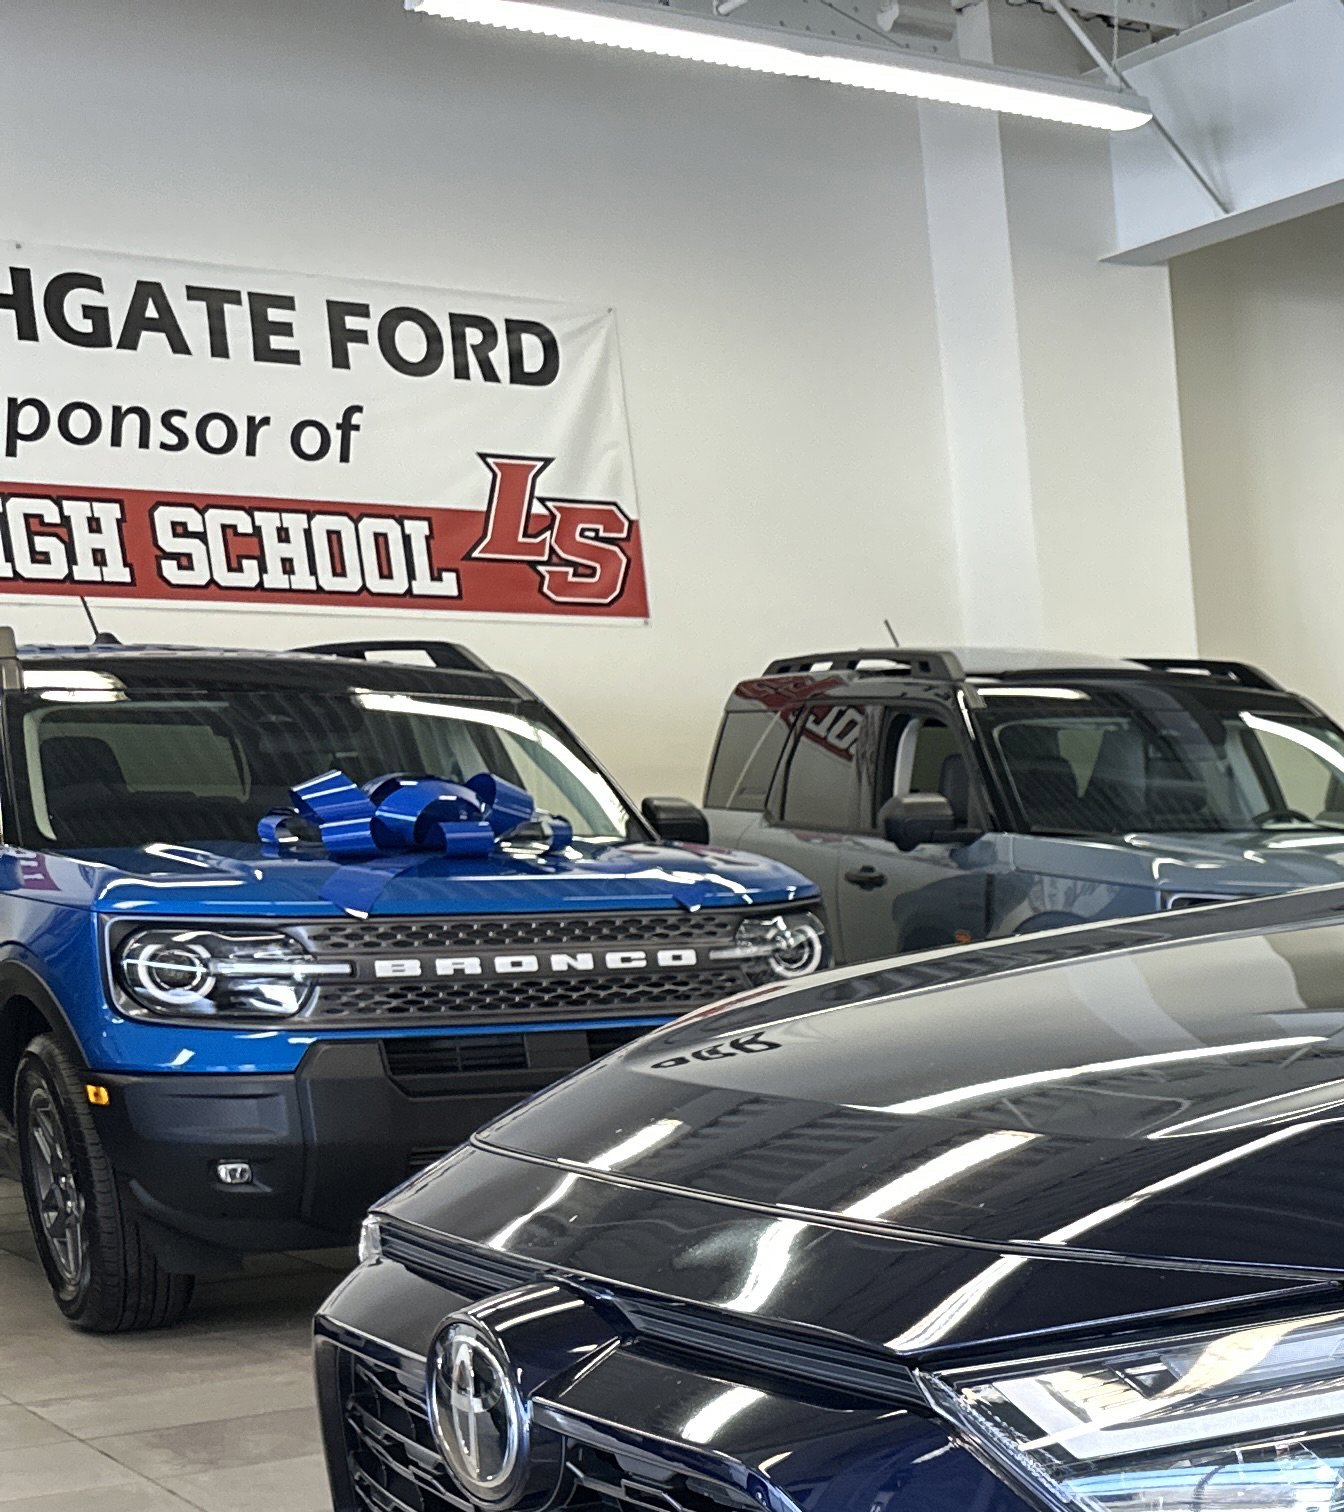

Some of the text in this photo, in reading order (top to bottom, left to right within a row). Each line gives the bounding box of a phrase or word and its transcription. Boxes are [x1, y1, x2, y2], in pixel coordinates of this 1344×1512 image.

[0, 266, 560, 386] HGATE FORD
[5, 396, 364, 463] ponsor of
[152, 503, 461, 599] SCHOOL
[374, 949, 697, 978] BRONCO
